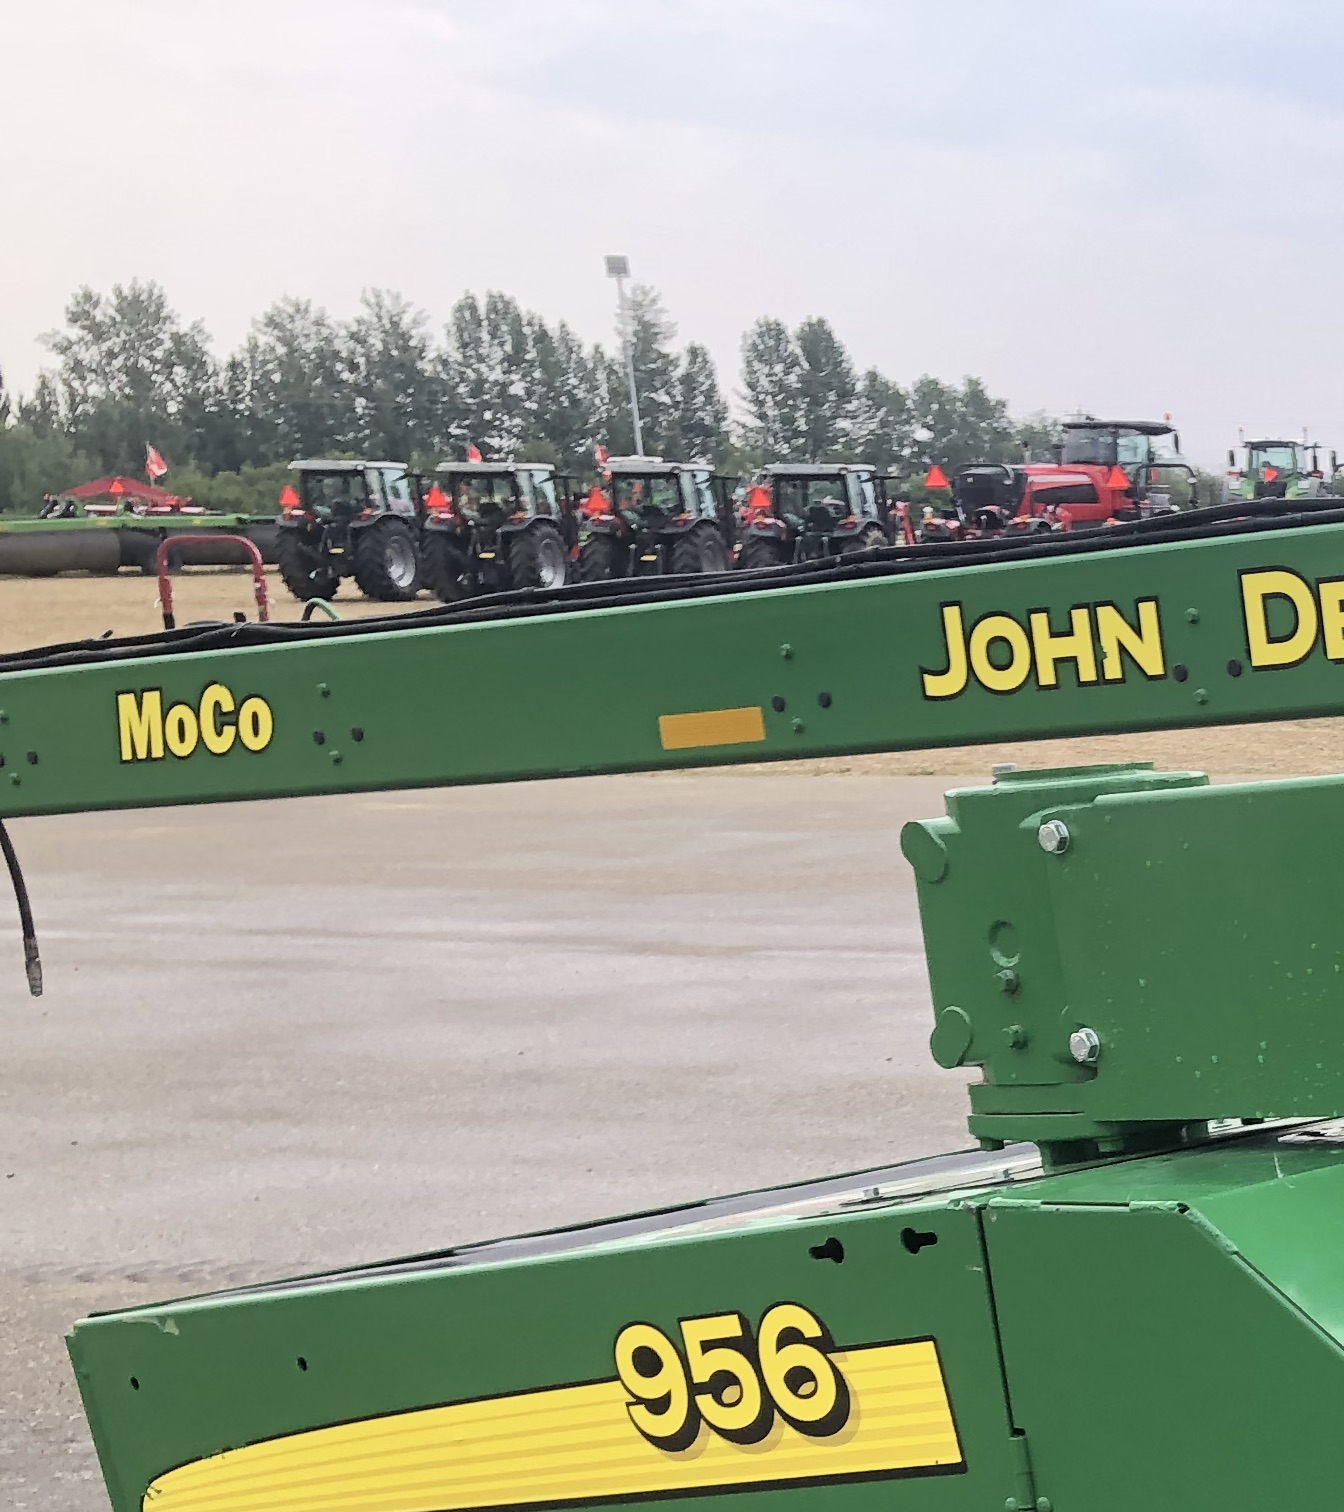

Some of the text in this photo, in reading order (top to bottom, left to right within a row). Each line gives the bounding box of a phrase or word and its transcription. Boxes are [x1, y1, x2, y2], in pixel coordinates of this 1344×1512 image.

[919, 597, 1166, 701] JOHN
[116, 681, 274, 764] MoCo
[614, 1301, 850, 1453] 956
